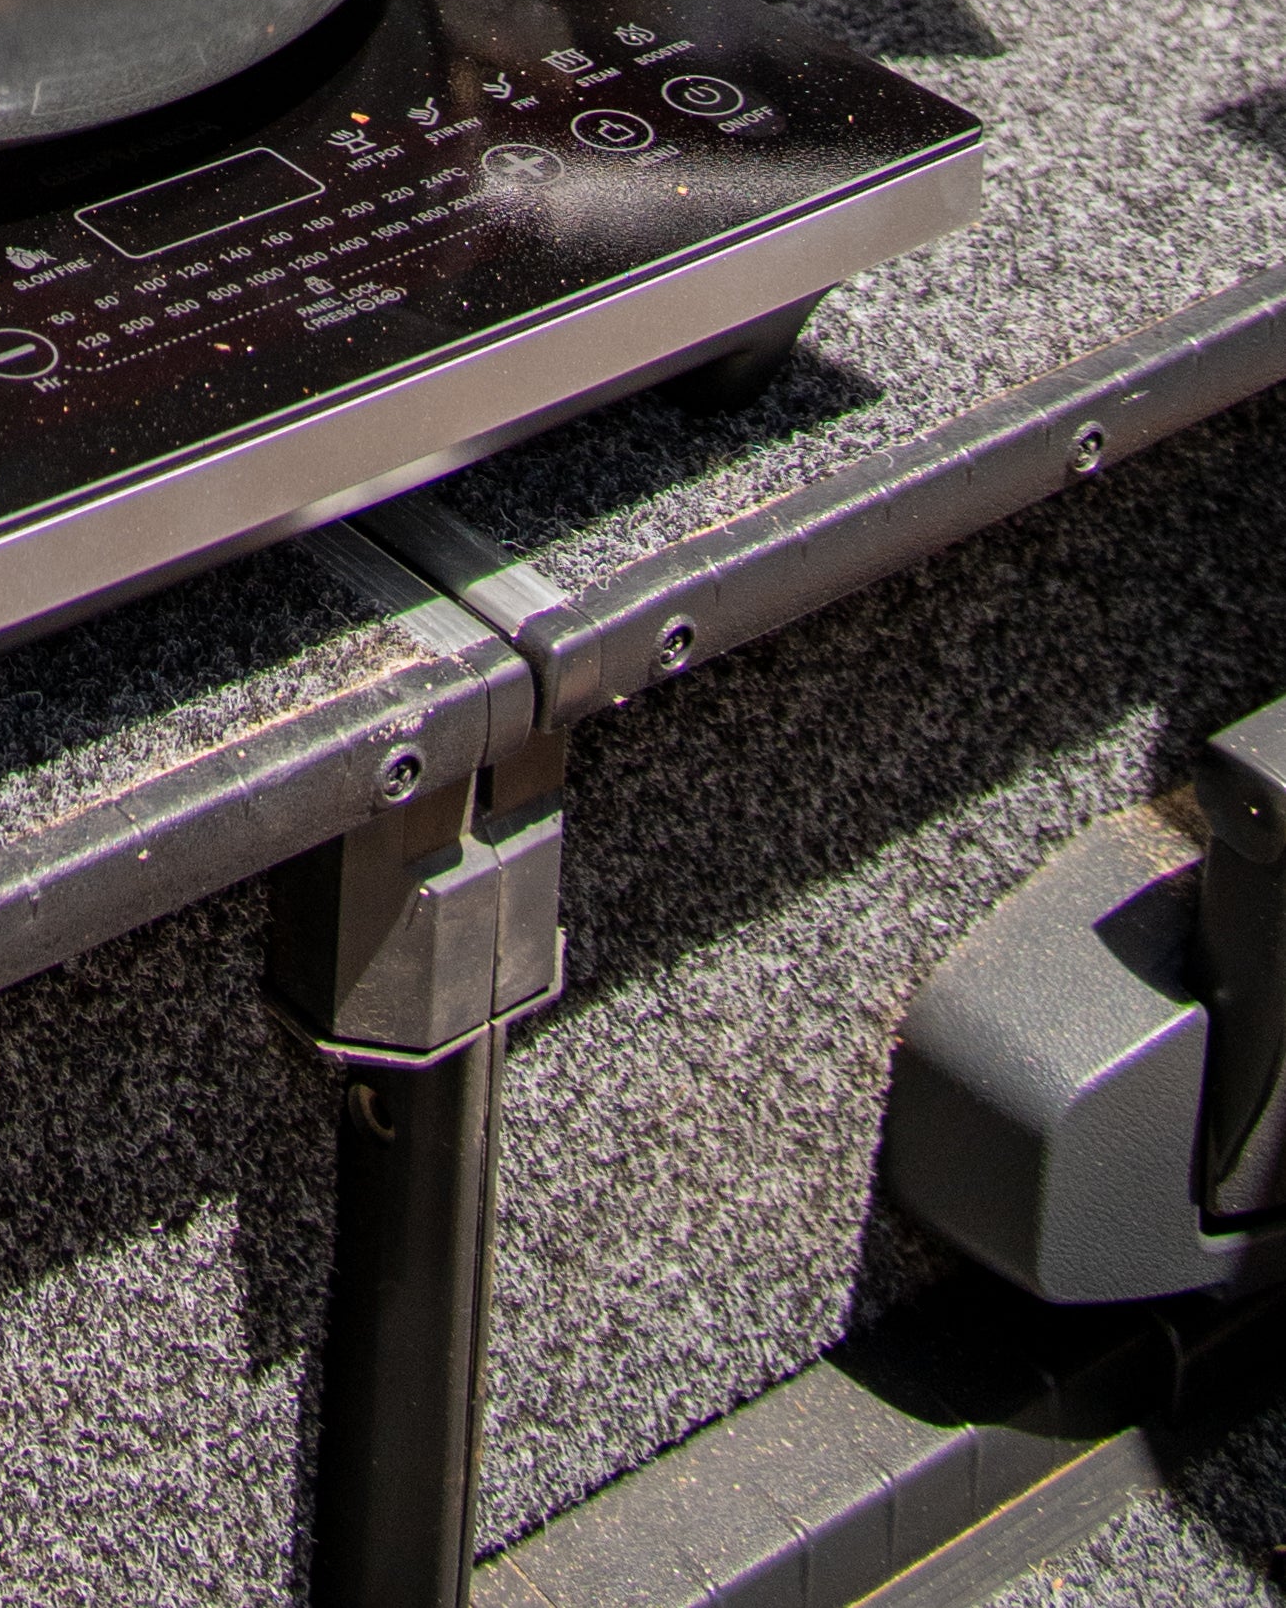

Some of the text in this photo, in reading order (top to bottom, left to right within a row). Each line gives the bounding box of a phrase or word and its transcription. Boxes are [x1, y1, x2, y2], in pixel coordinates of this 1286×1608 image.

[633, 40, 697, 66] BOOSTER
[575, 67, 622, 89] STEAM
[511, 95, 541, 112] FRY
[425, 116, 483, 145] STIR FRY
[717, 105, 776, 135] ON/OFF
[346, 144, 406, 173] HOT POT
[631, 144, 681, 169] MENU
[50, 310, 76, 327] 60
[94, 294, 120, 312] 80
[134, 276, 167, 296] 100
[176, 261, 210, 281] 120
[219, 245, 252, 265] 140
[261, 230, 294, 250] 160
[302, 215, 335, 234] 180
[341, 200, 376, 220] 200
[381, 185, 415, 205] 220
[13, 257, 93, 292] SLOW FIRE
[76, 331, 111, 352] 120
[119, 315, 155, 336] 300
[165, 298, 201, 319] 500
[207, 283, 243, 303] 800
[246, 266, 286, 288] 1000
[288, 250, 328, 272] 1200
[330, 235, 369, 257] 1400
[371, 220, 411, 241] 1600
[411, 204, 450, 226] 1800
[296, 293, 341, 317] PANEL
